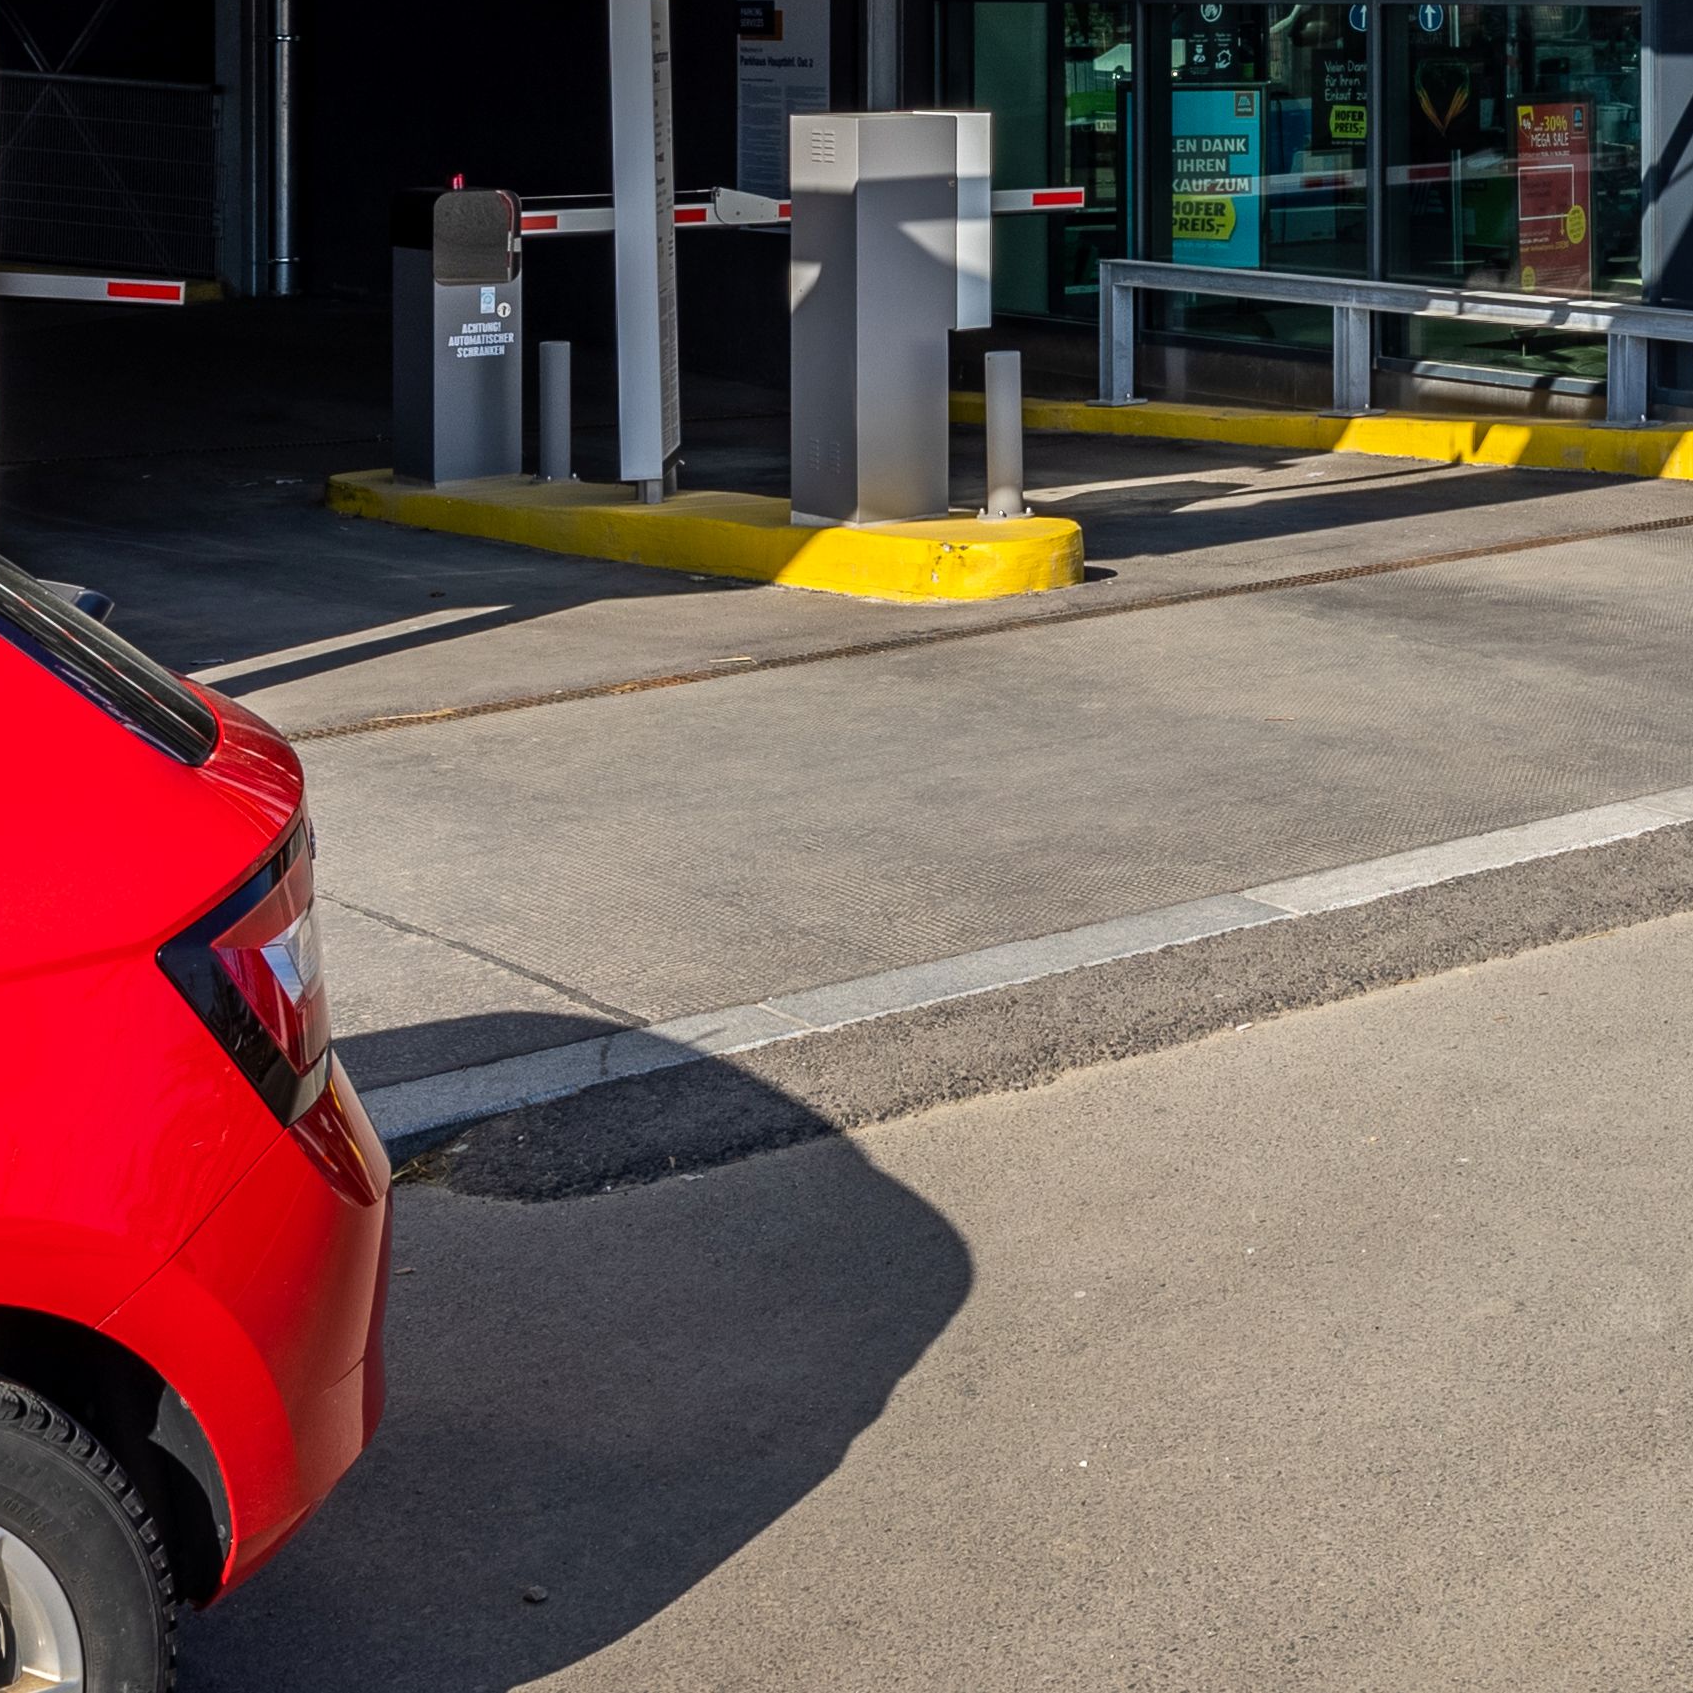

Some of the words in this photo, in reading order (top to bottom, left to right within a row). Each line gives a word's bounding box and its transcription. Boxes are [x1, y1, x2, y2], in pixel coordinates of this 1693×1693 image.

[1334, 110, 1365, 123] HOFER
[1201, 137, 1248, 153] DANK
[1530, 134, 1551, 148] MEGA
[1552, 132, 1570, 146] SALE
[1176, 158, 1227, 173] IHREN
[1214, 177, 1250, 192] ZUM
[461, 321, 502, 335] ACHTUNG!
[448, 332, 515, 347] AUTOMATISCHER
[456, 344, 506, 358] SCHRANKEN
